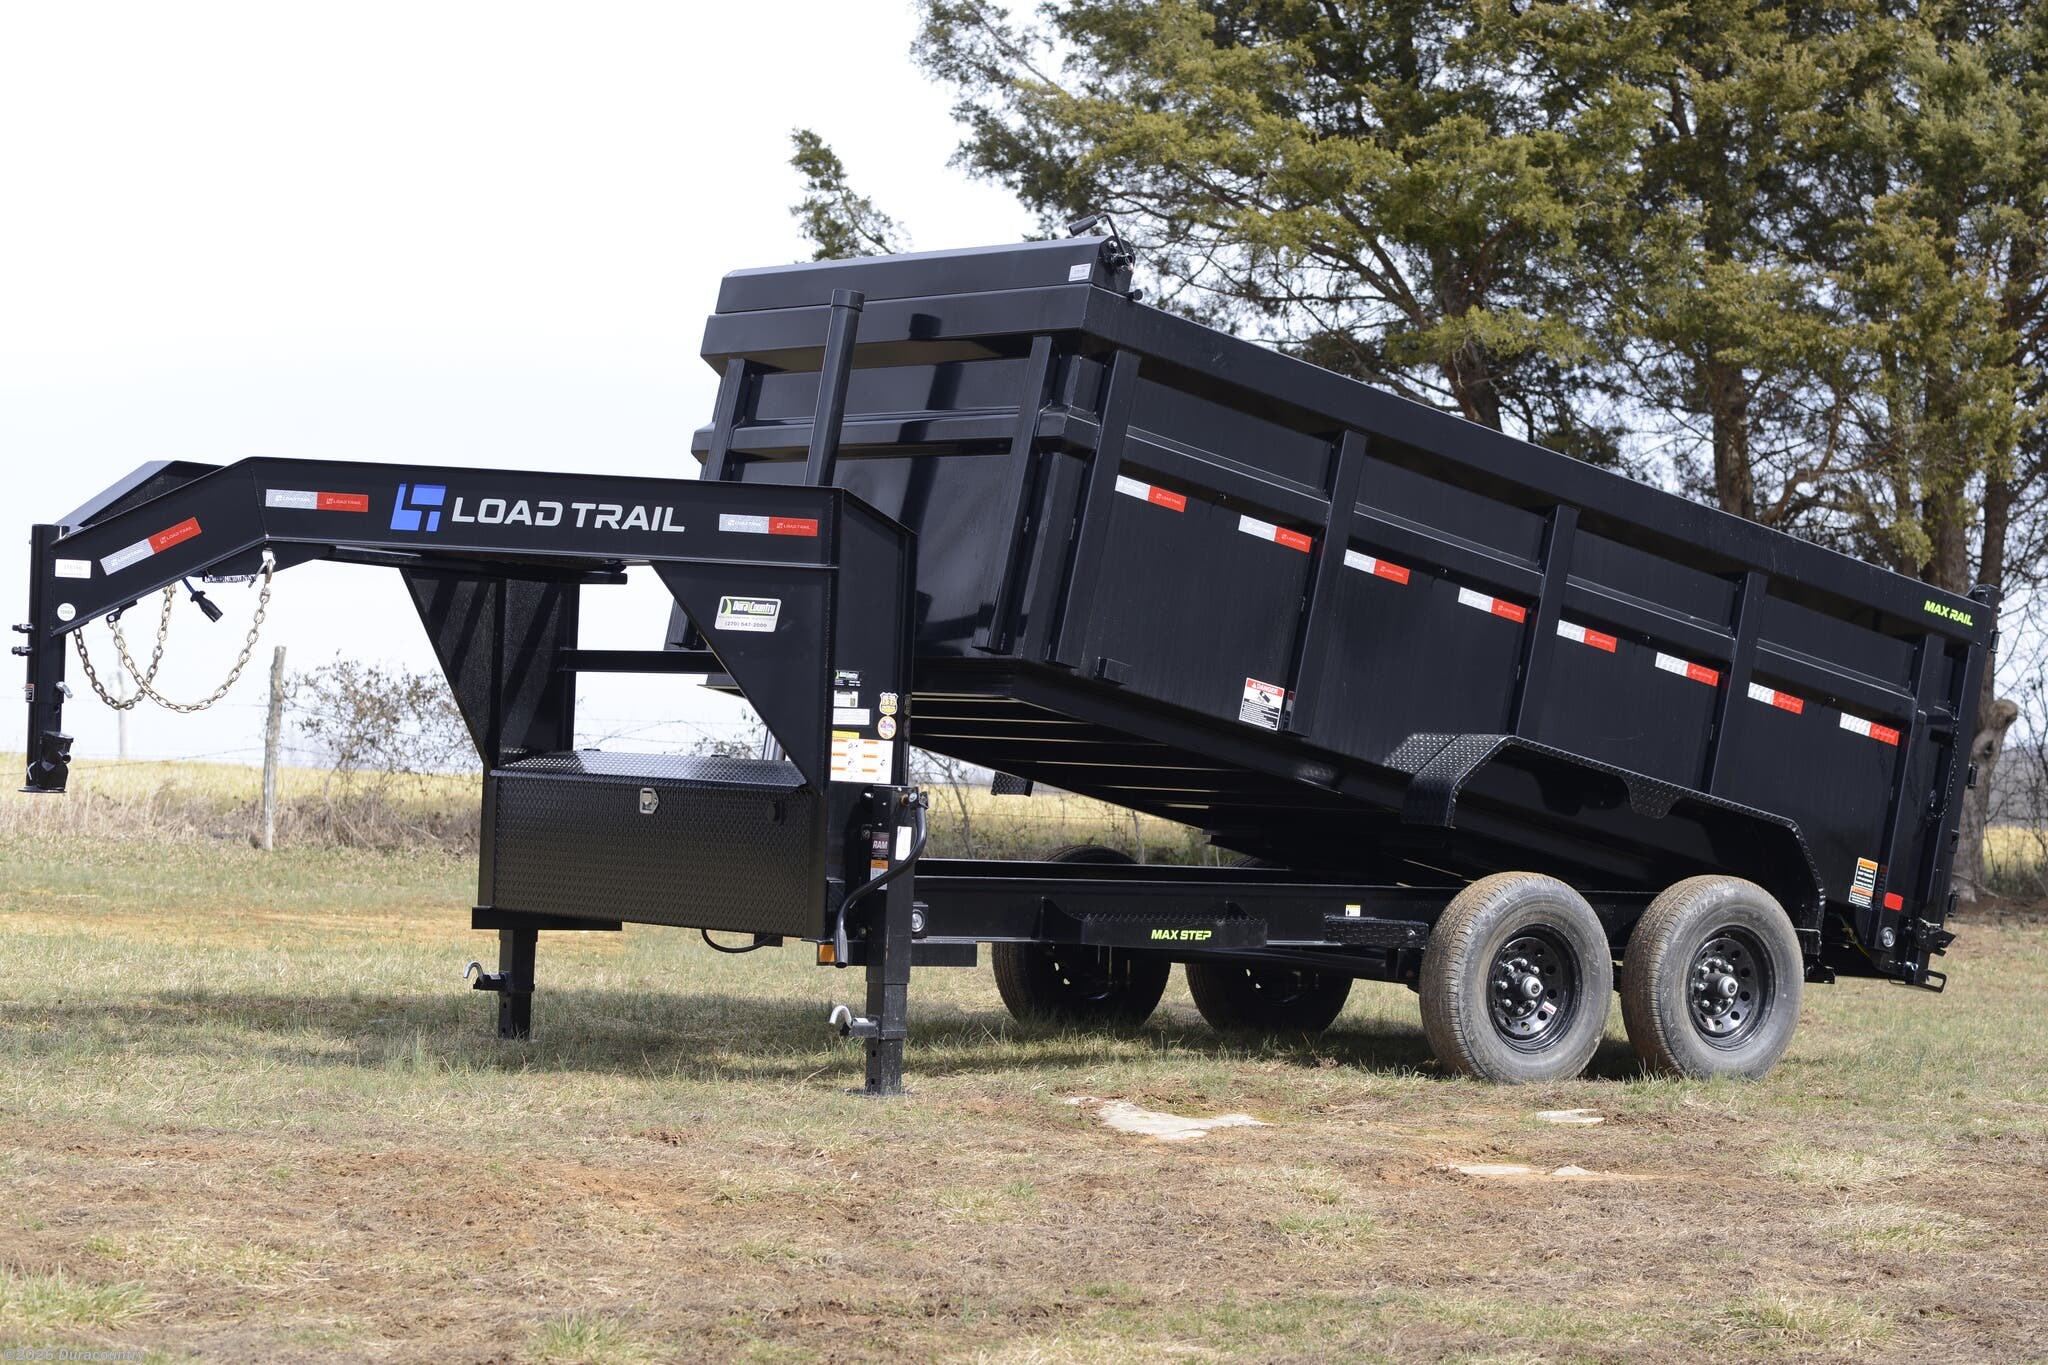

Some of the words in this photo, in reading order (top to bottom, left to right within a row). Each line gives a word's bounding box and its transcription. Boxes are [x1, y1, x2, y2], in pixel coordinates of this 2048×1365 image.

[451, 496, 564, 527] LOAD
[571, 502, 686, 533] TRAIL
[1924, 600, 1950, 618] MAX
[1949, 609, 1973, 626] RAIL
[1151, 929, 1179, 940] MAX
[1180, 930, 1212, 940] STEP
